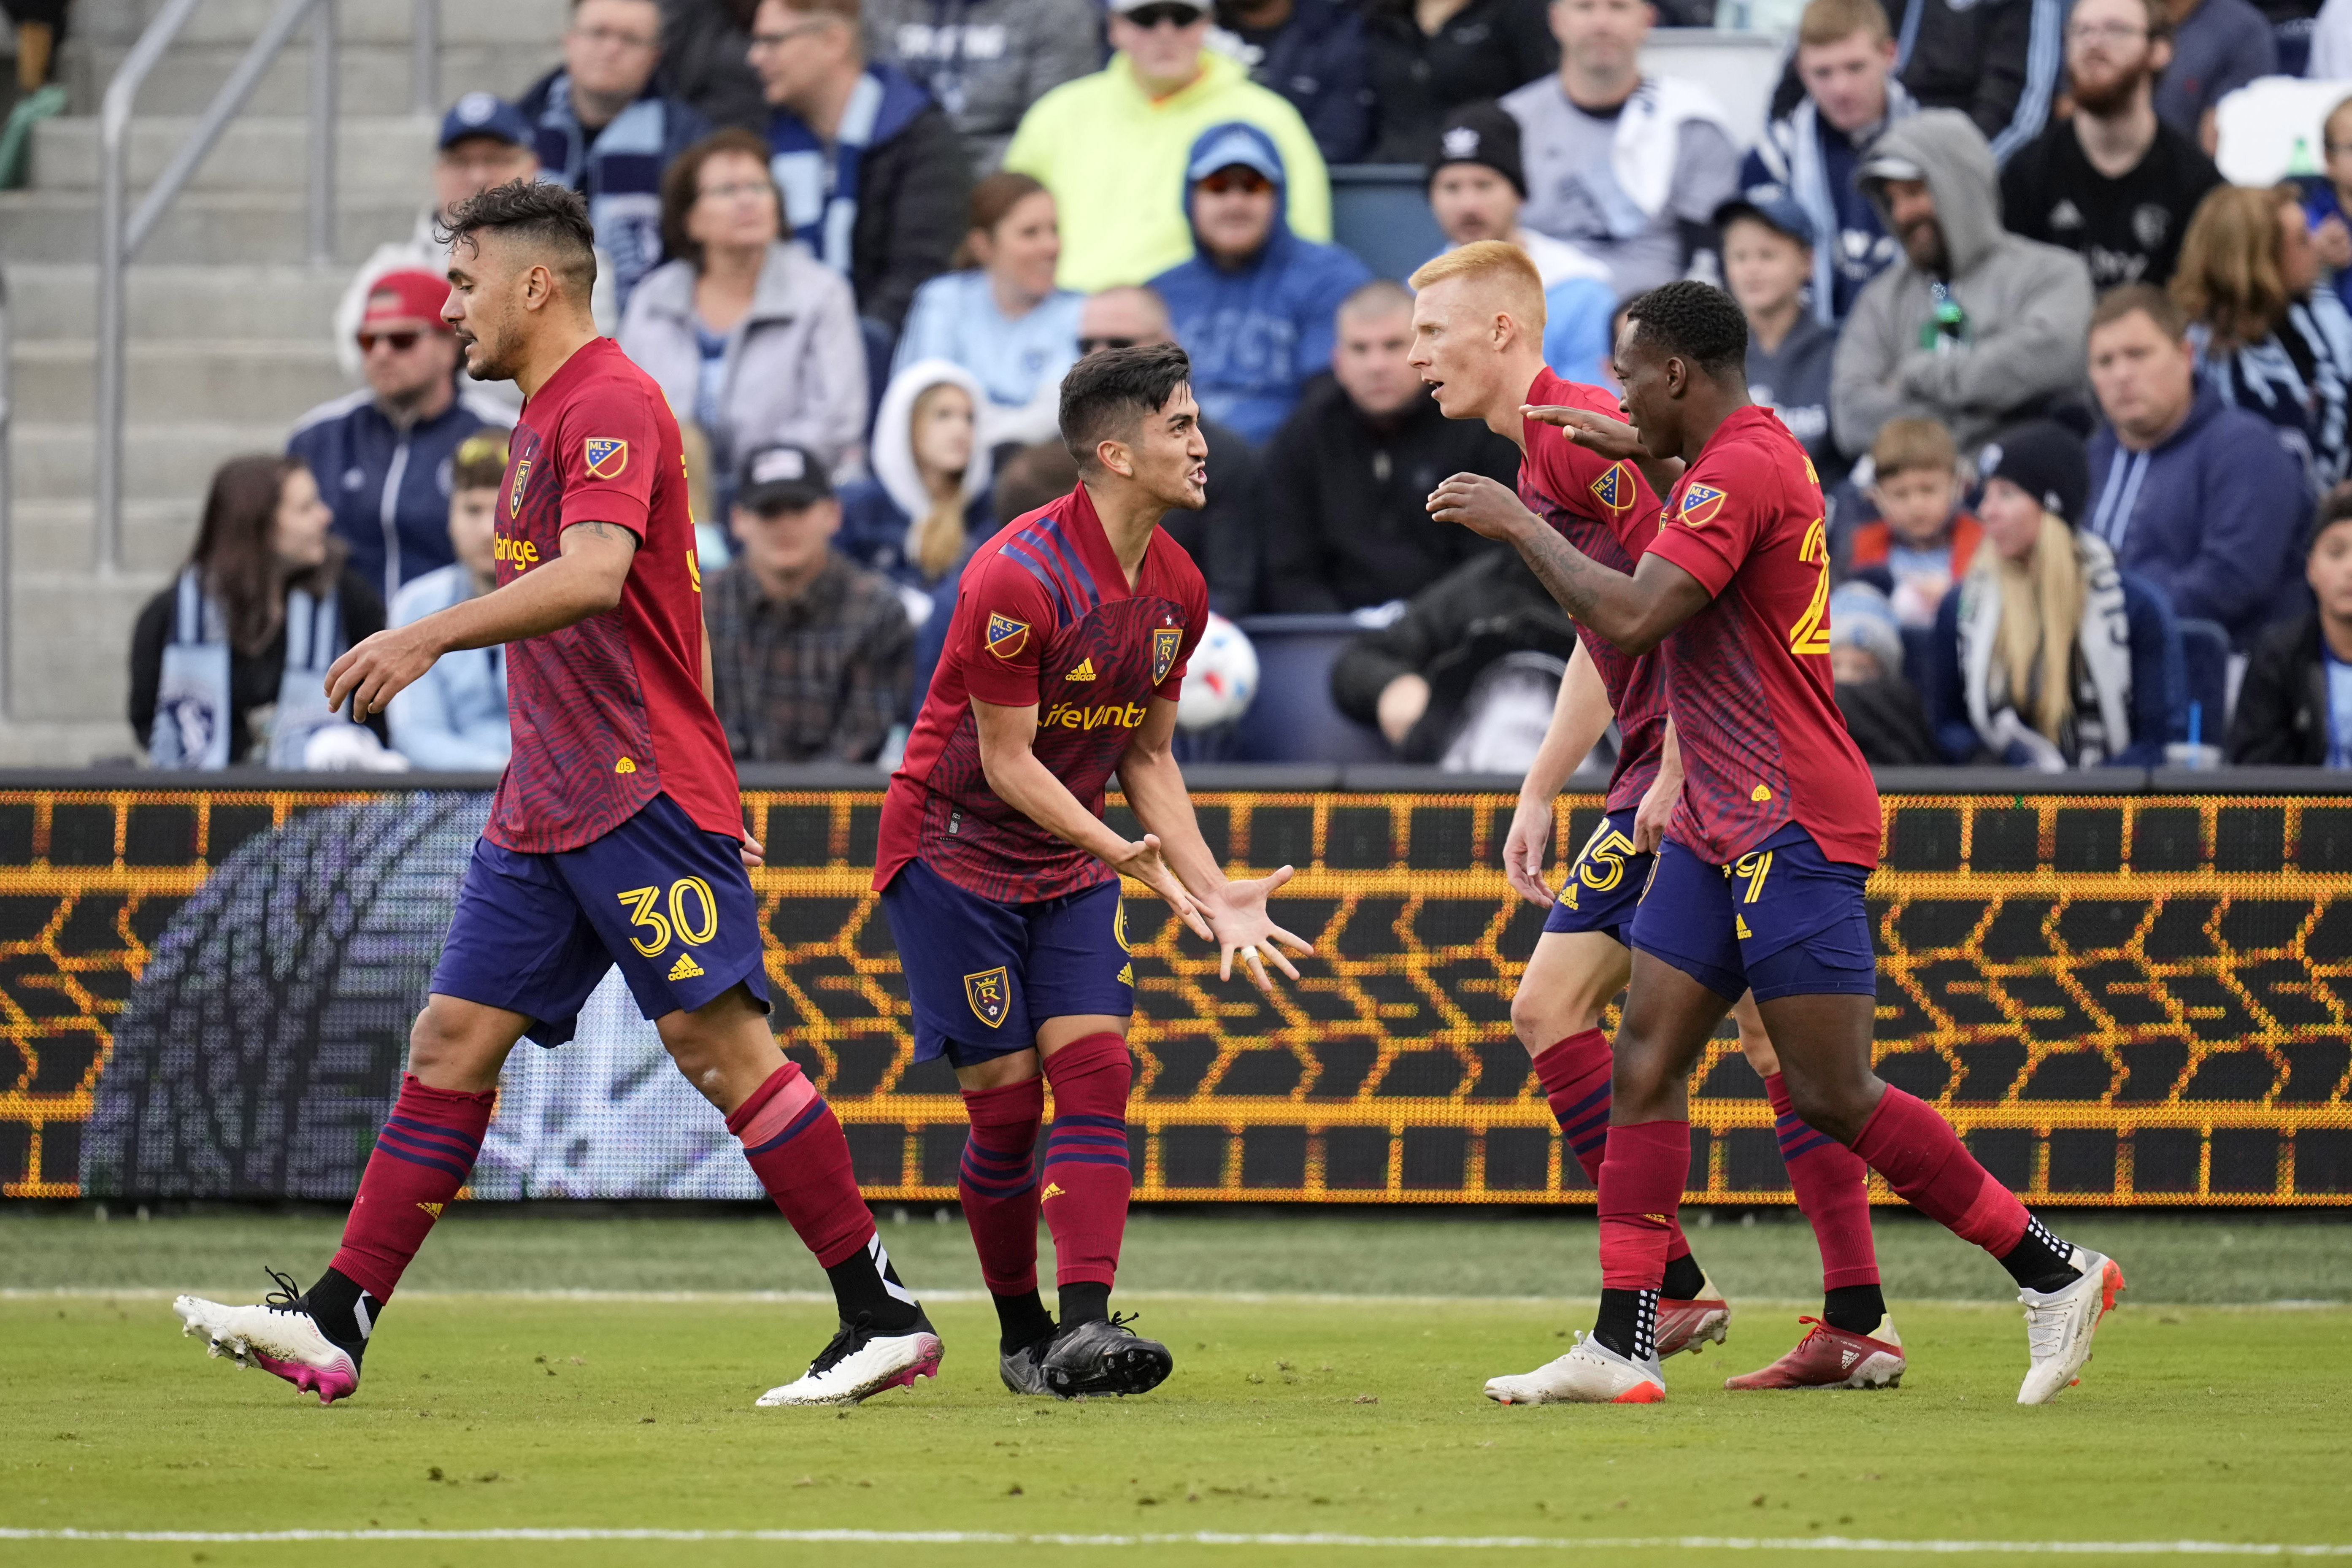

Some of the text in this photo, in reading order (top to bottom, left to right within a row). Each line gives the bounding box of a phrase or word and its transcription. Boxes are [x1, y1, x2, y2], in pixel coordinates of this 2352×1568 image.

[590, 441, 611, 451] MLS
[1594, 475, 1614, 494] MLS
[1690, 487, 1710, 499] MLS
[992, 617, 1013, 632] MLS
[1065, 673, 1096, 681] adidas
[619, 762, 631, 770] 05
[1755, 789, 1766, 798] 05
[1570, 817, 1637, 891] 15
[1722, 852, 1773, 903] 9
[616, 876, 718, 957] 30
[668, 968, 704, 981] adidas
[307, 1321, 319, 1338] COPA
[1842, 1352, 1860, 1370] adidas
